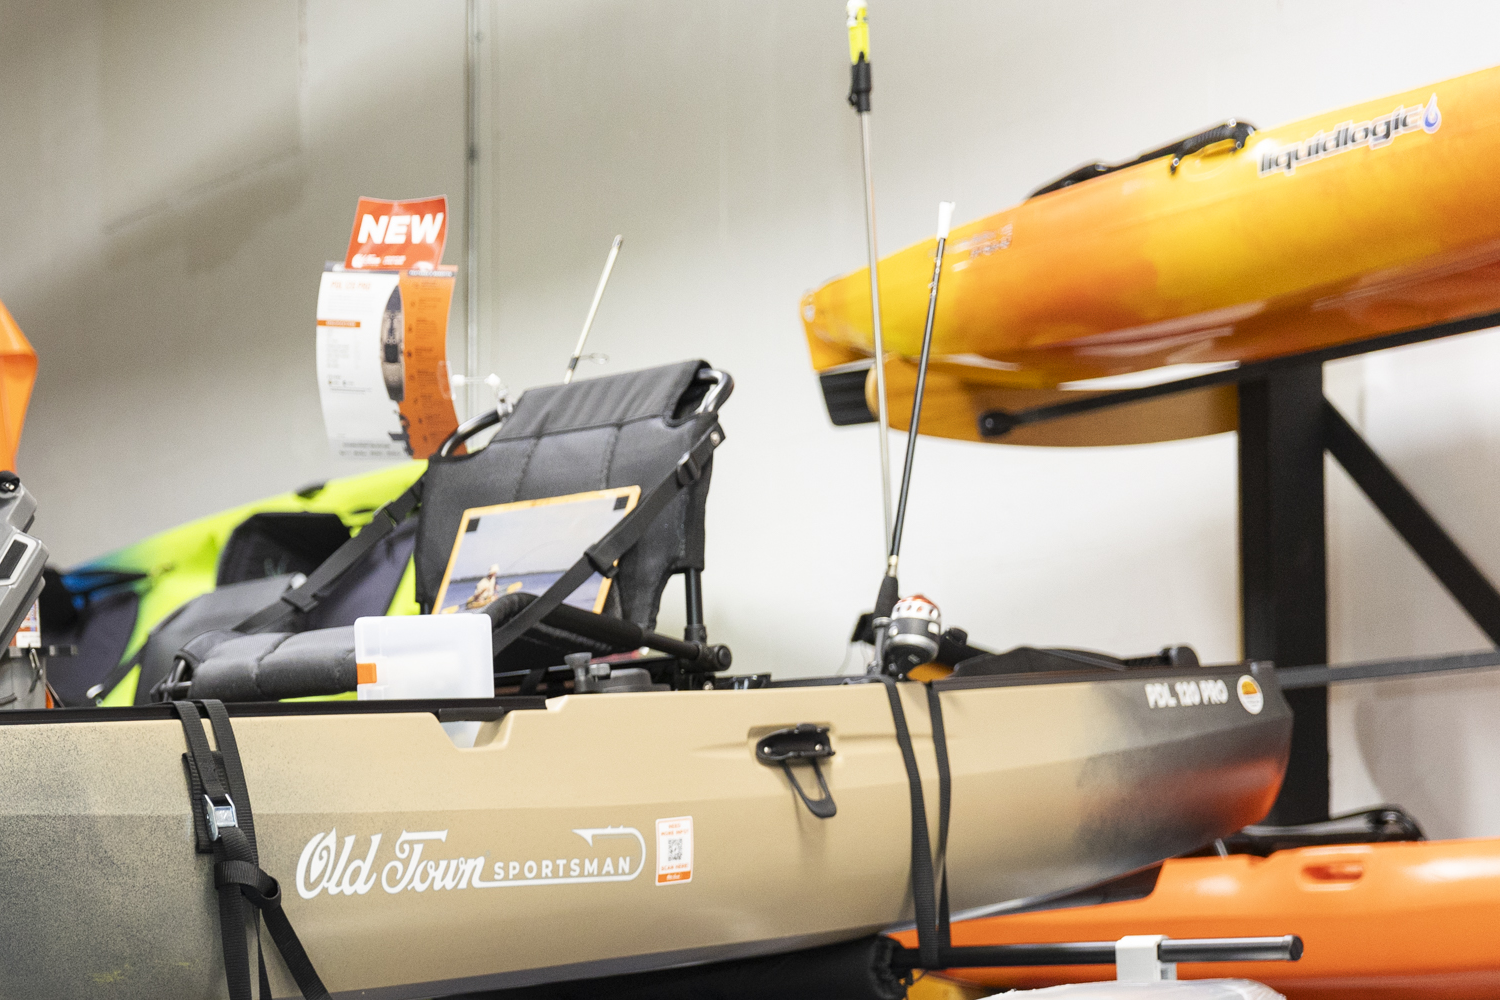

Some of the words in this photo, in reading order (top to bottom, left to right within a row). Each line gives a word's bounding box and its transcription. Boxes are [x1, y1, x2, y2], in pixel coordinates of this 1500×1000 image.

[1260, 106, 1424, 173] liquidlogic
[357, 212, 444, 244] NEW
[1144, 682, 1177, 709] PDL
[1174, 680, 1200, 707] 120
[1199, 679, 1229, 705] PRO
[295, 826, 383, 900] Old
[381, 828, 486, 895] Town
[493, 855, 632, 882] SPORTSMAN
